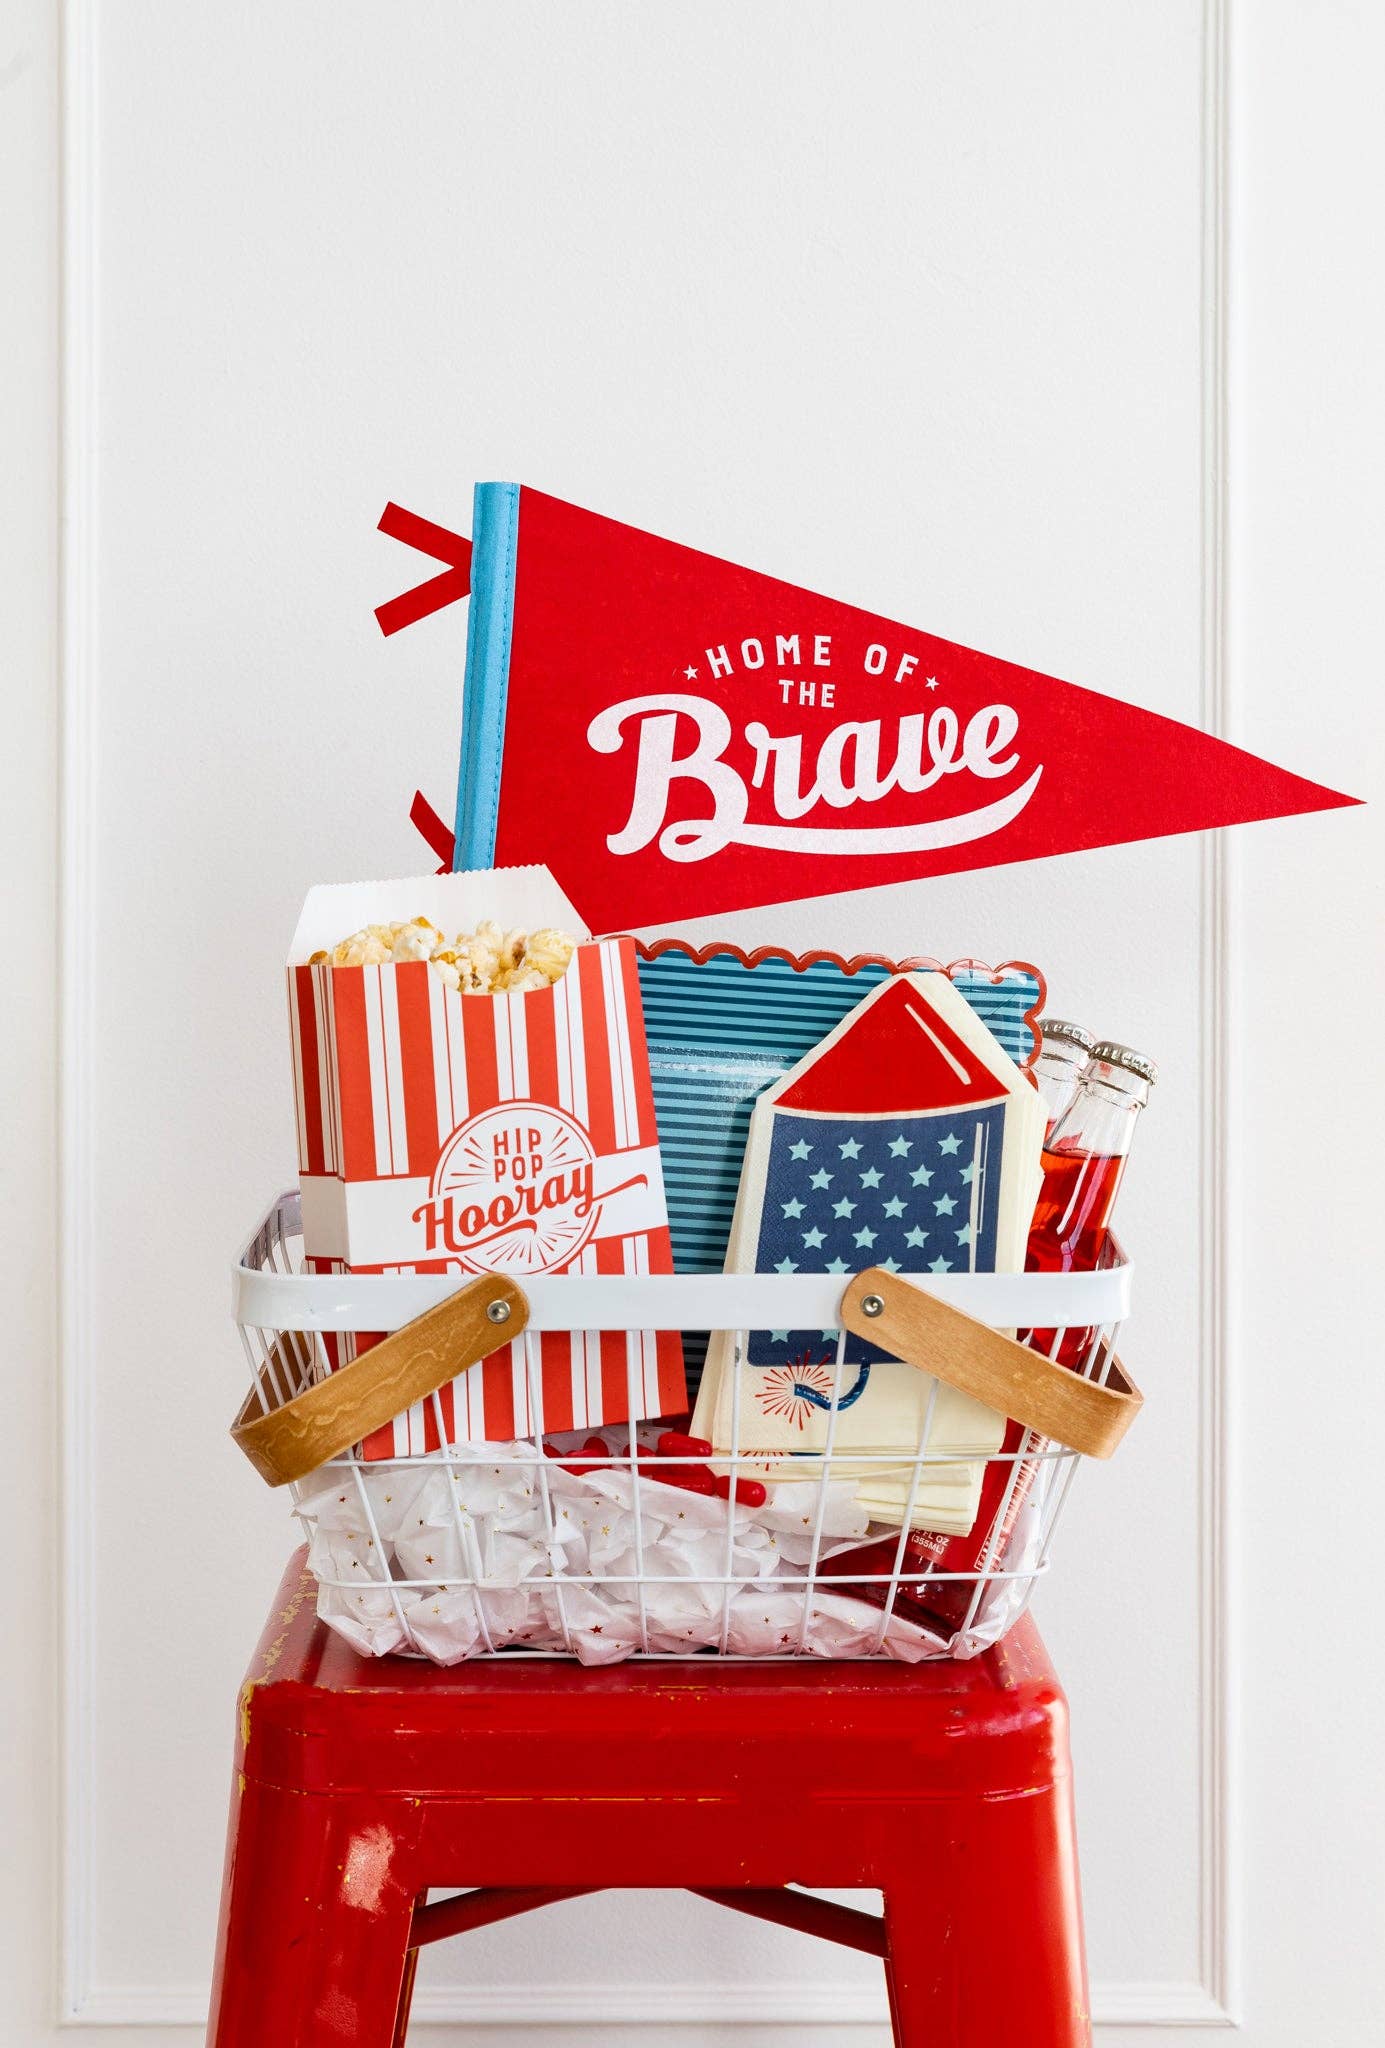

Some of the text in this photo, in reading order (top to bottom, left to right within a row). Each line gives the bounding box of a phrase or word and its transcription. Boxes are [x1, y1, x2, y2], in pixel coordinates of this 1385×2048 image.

[704, 634, 920, 683] HOME OF
[778, 679, 836, 709] THE
[586, 693, 1044, 863] Brave
[493, 1127, 542, 1156] HIP
[494, 1154, 543, 1183] POP
[412, 1162, 648, 1252] Hooray
[935, 1534, 950, 1547] OZ
